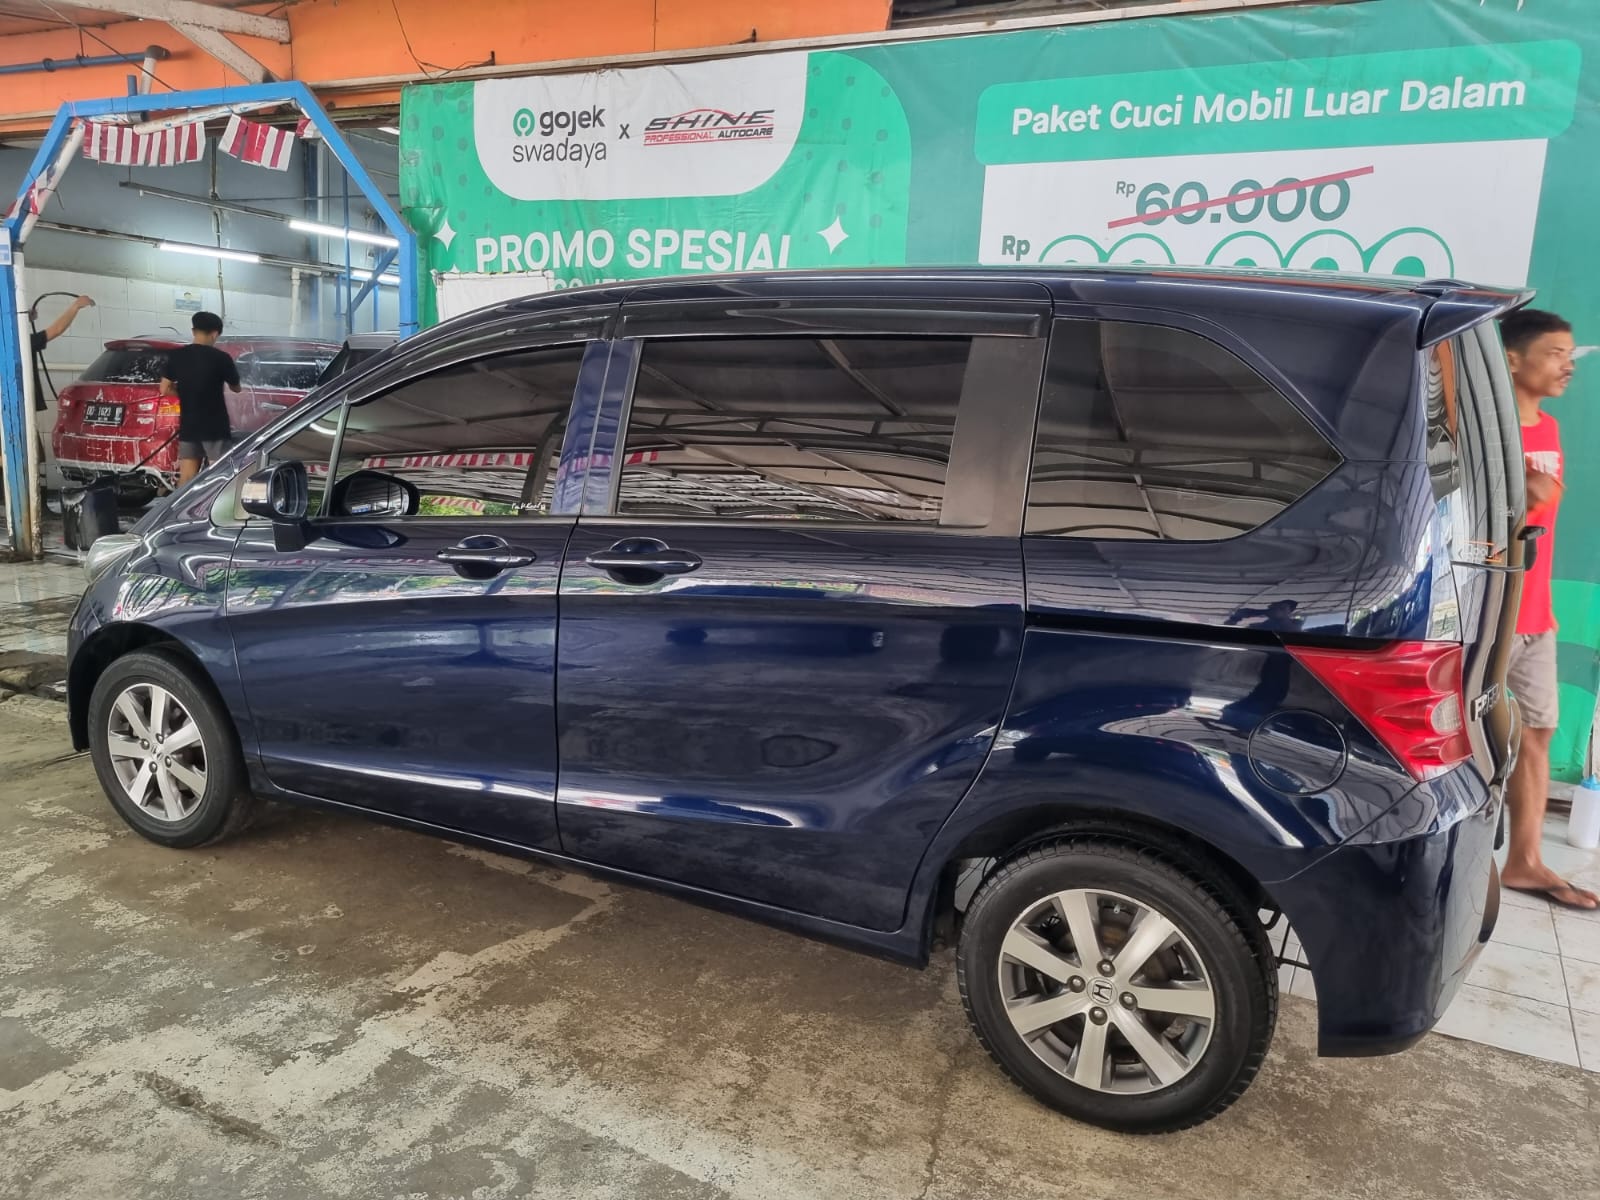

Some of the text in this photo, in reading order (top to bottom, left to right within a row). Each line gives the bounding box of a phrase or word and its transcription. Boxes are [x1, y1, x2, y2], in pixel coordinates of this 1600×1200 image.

[539, 105, 606, 137] gojek
[645, 109, 775, 131] SHINE
[1012, 76, 1526, 136] Paket Cuci Mobil Luar Dalam
[643, 126, 774, 143] PROFESSIONAL AUTOCARE
[512, 137, 607, 168] swadaya
[1115, 174, 1352, 226] Rp 60.000
[475, 229, 615, 272] PROMO
[1001, 234, 1031, 260] Rp
